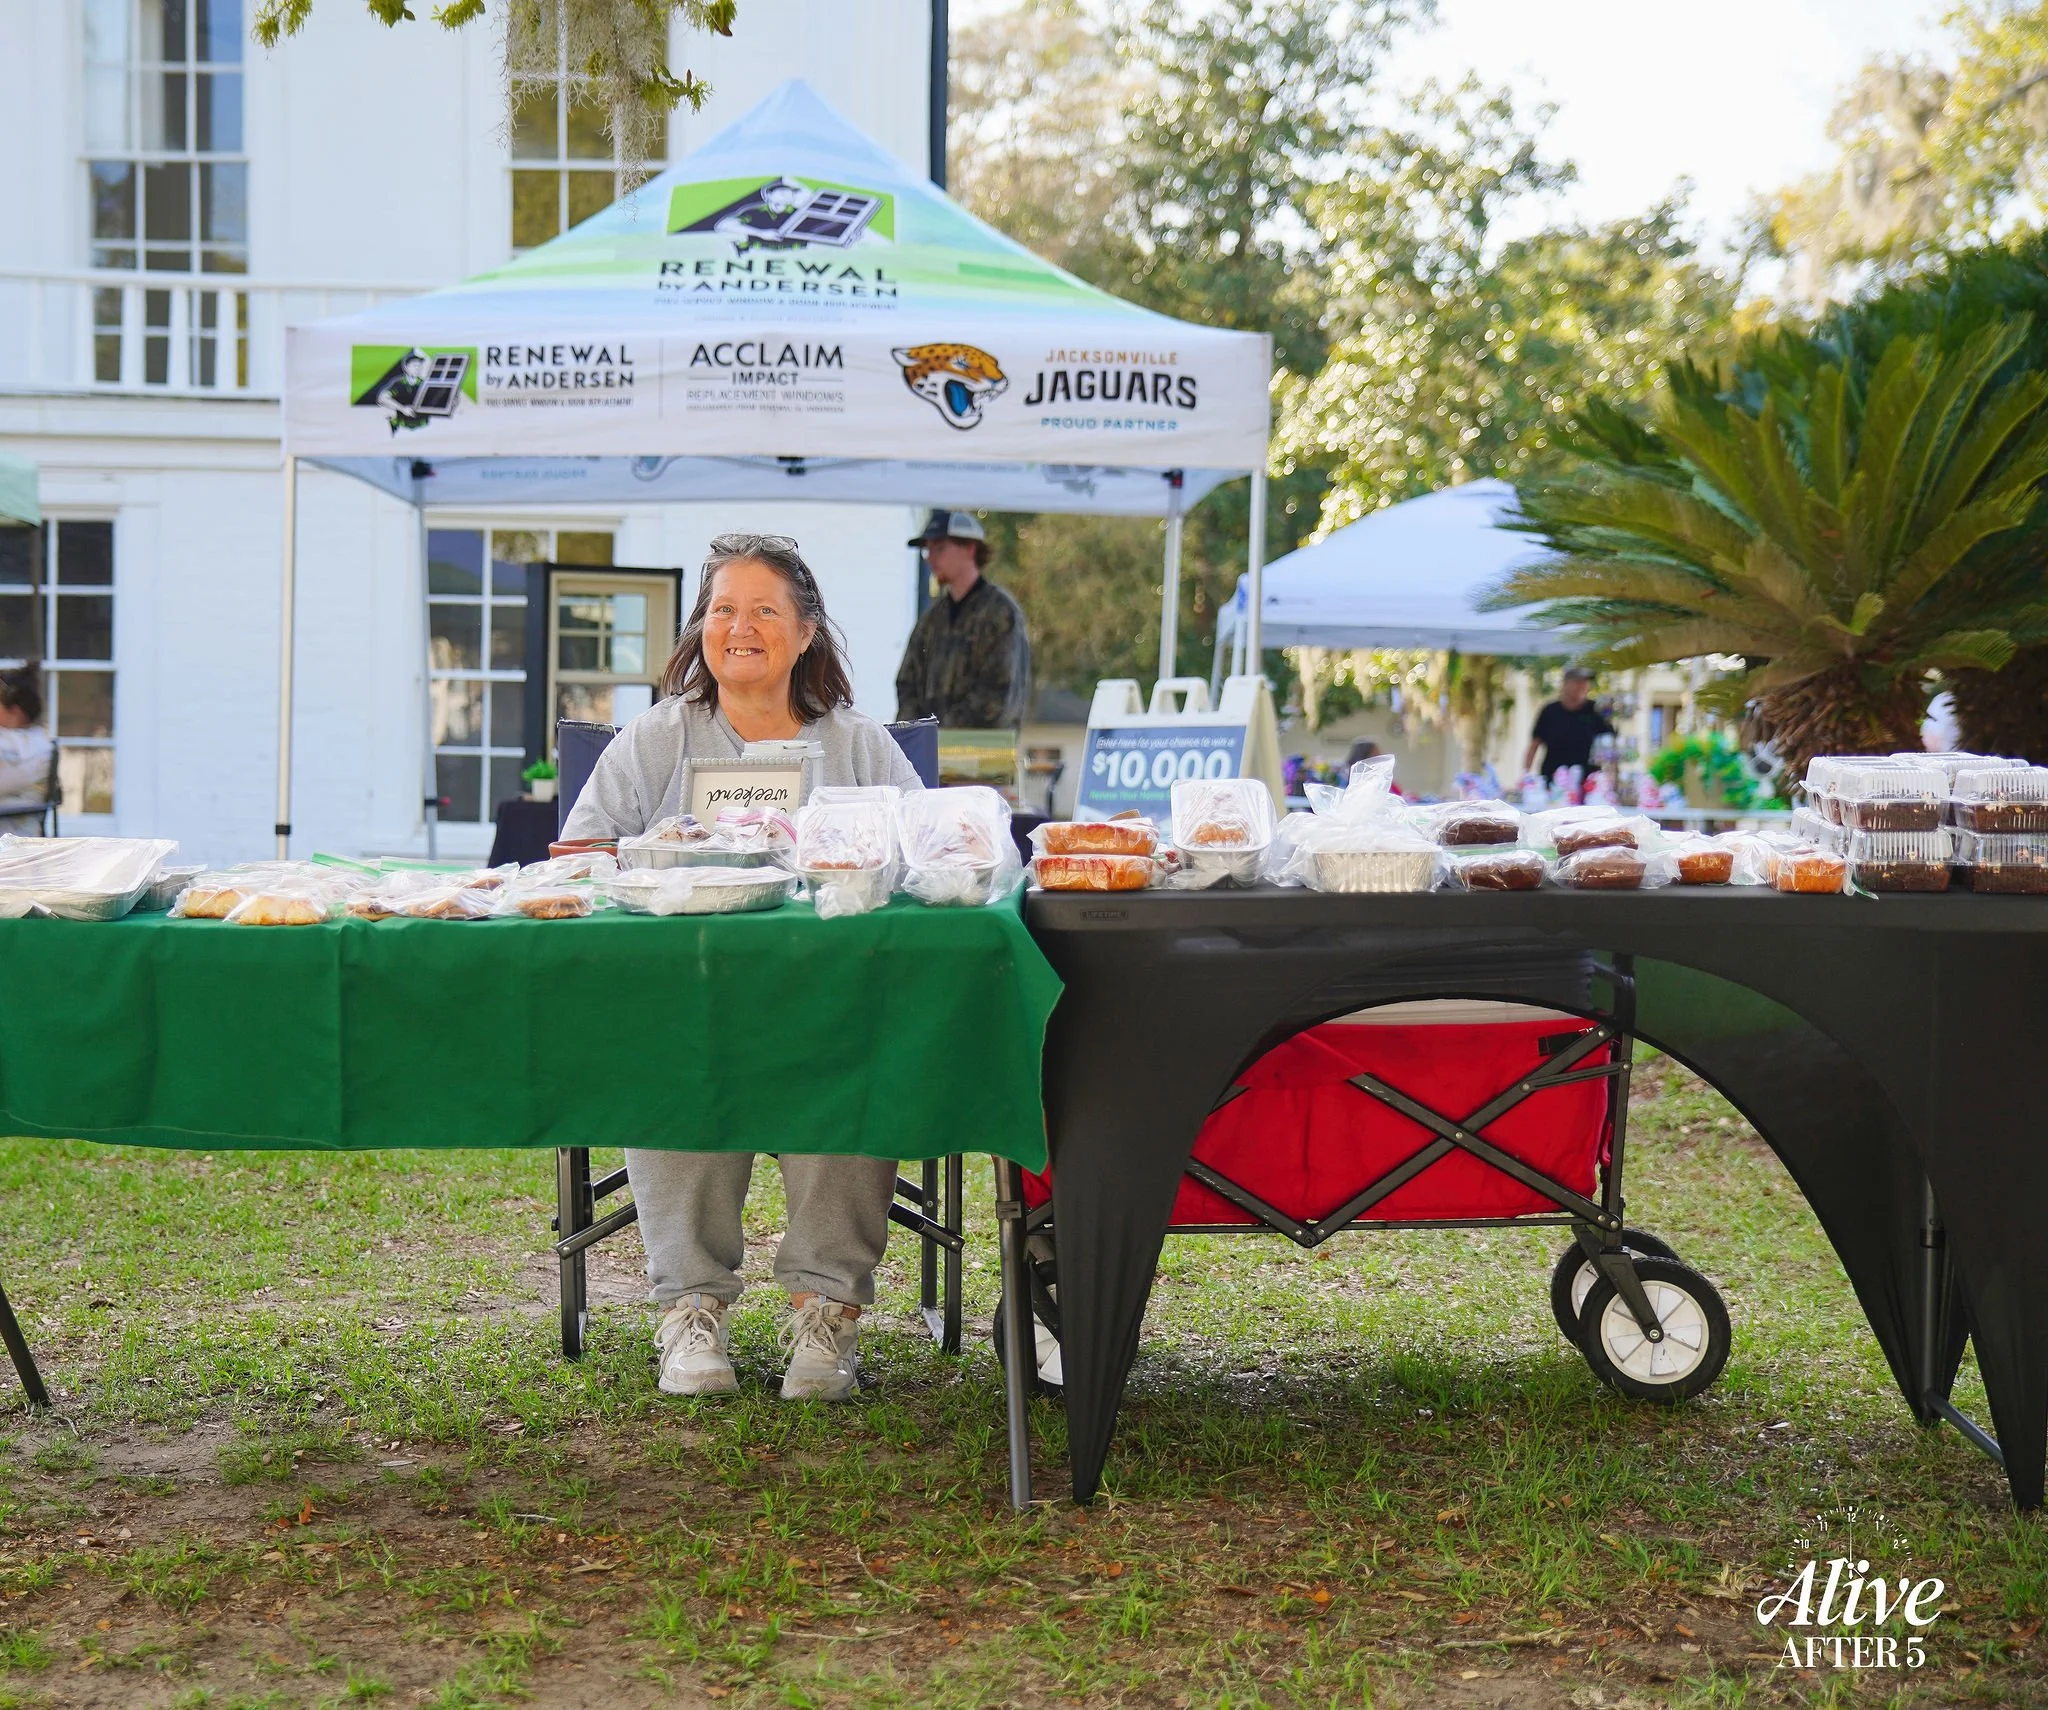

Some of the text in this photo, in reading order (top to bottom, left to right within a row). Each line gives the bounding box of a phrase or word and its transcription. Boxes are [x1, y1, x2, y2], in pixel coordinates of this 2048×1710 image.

[660, 259, 897, 284] RENEWAL
[657, 279, 897, 298] by ANDERSEN
[486, 344, 634, 367] RENEWAL
[690, 342, 844, 369] ACCLAIM
[1045, 350, 1178, 365] JACKSONVILLE
[486, 371, 635, 389] by ANDERSEN
[732, 372, 799, 385] IMPACT
[686, 390, 844, 403] REPLACEMENT WINDOWS
[1024, 370, 1197, 411] JAGUARS
[1041, 417, 1177, 431] PROUD PARTNER
[1092, 750, 1232, 791] $10,000
[706, 786, 788, 809] weekend
